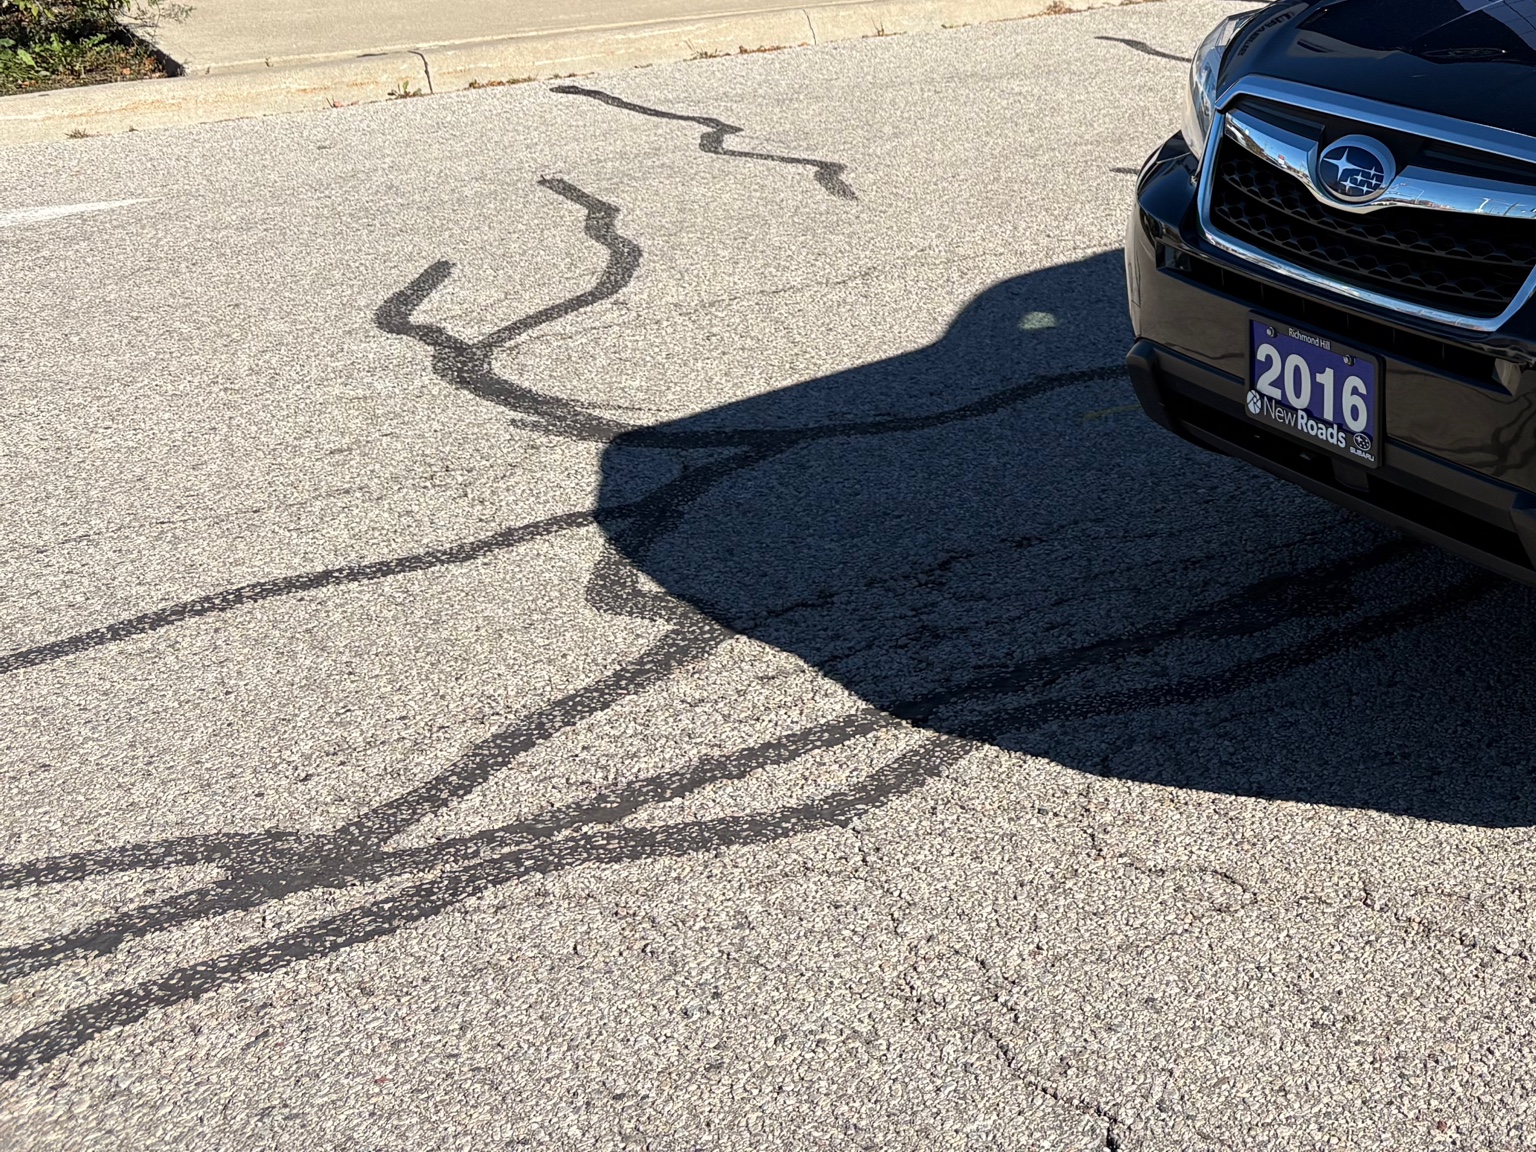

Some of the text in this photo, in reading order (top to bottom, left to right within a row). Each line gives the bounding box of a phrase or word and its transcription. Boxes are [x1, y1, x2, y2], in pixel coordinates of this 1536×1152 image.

[1288, 328, 1331, 350] Richmond Hill
[1256, 343, 1367, 432] 2016
[1349, 446, 1375, 462] SUBARU
